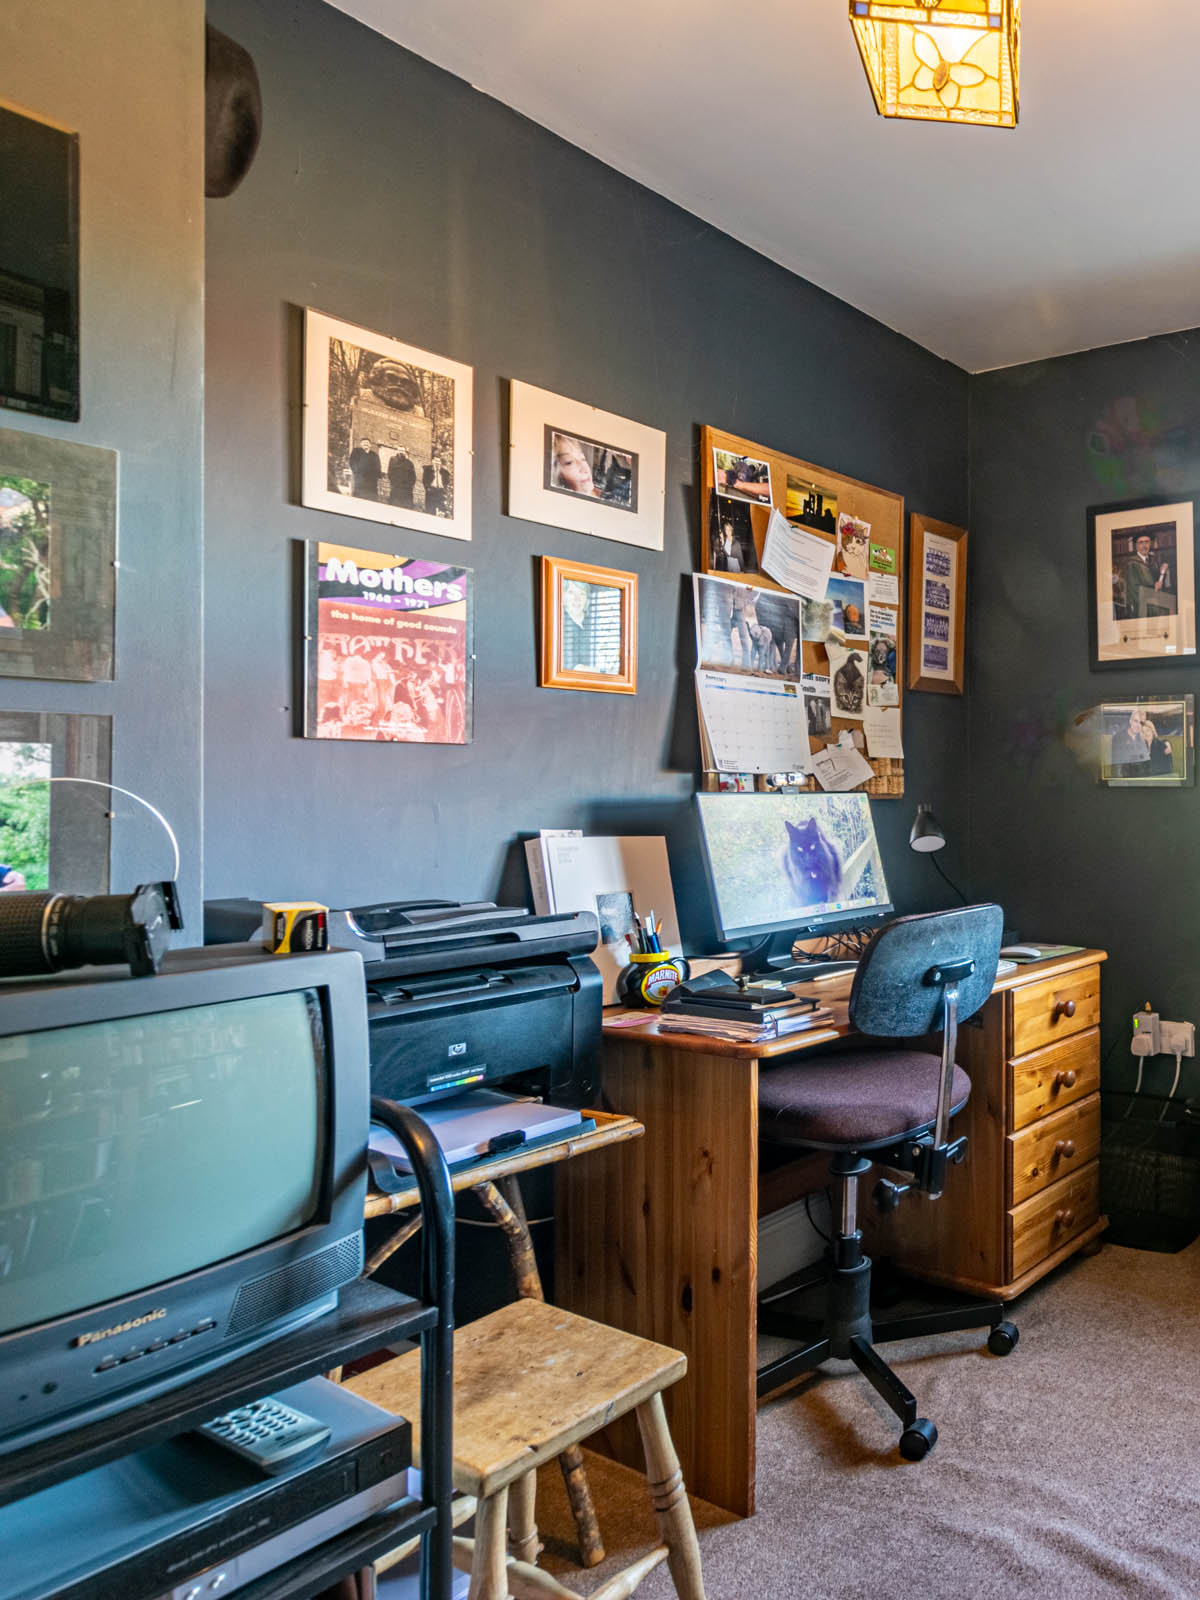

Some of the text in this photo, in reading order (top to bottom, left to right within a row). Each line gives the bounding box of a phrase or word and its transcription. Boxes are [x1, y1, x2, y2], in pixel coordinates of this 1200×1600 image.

[325, 557, 463, 601] Mothers
[362, 591, 392, 604] 1968
[404, 597, 430, 609] 1971
[330, 610, 457, 634] the home of good sounds
[801, 684, 816, 693] mith
[79, 1308, 167, 1348] Panasonic
